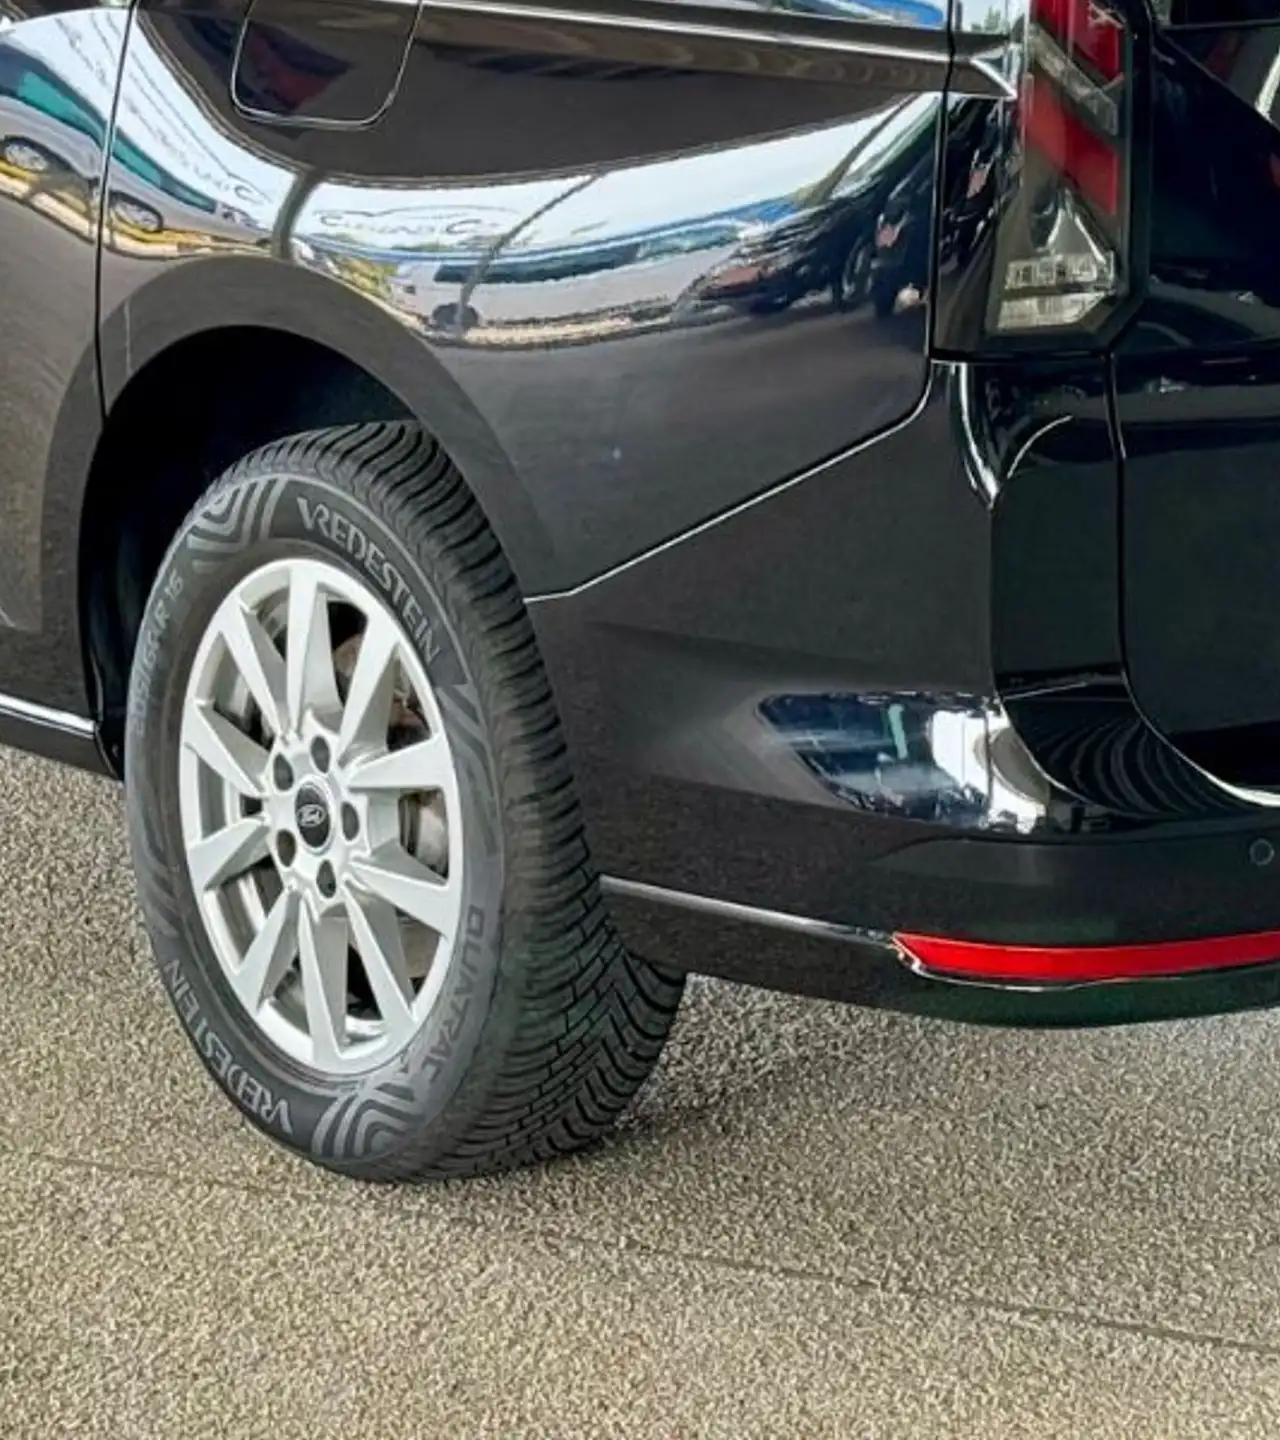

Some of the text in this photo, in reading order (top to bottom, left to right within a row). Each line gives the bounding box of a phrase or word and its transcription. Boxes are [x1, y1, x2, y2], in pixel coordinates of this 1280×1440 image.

[296, 496, 442, 664] VREDESTEIN
[163, 958, 295, 1136] VREDESTEIN
[421, 903, 486, 1084] QUATRAC
